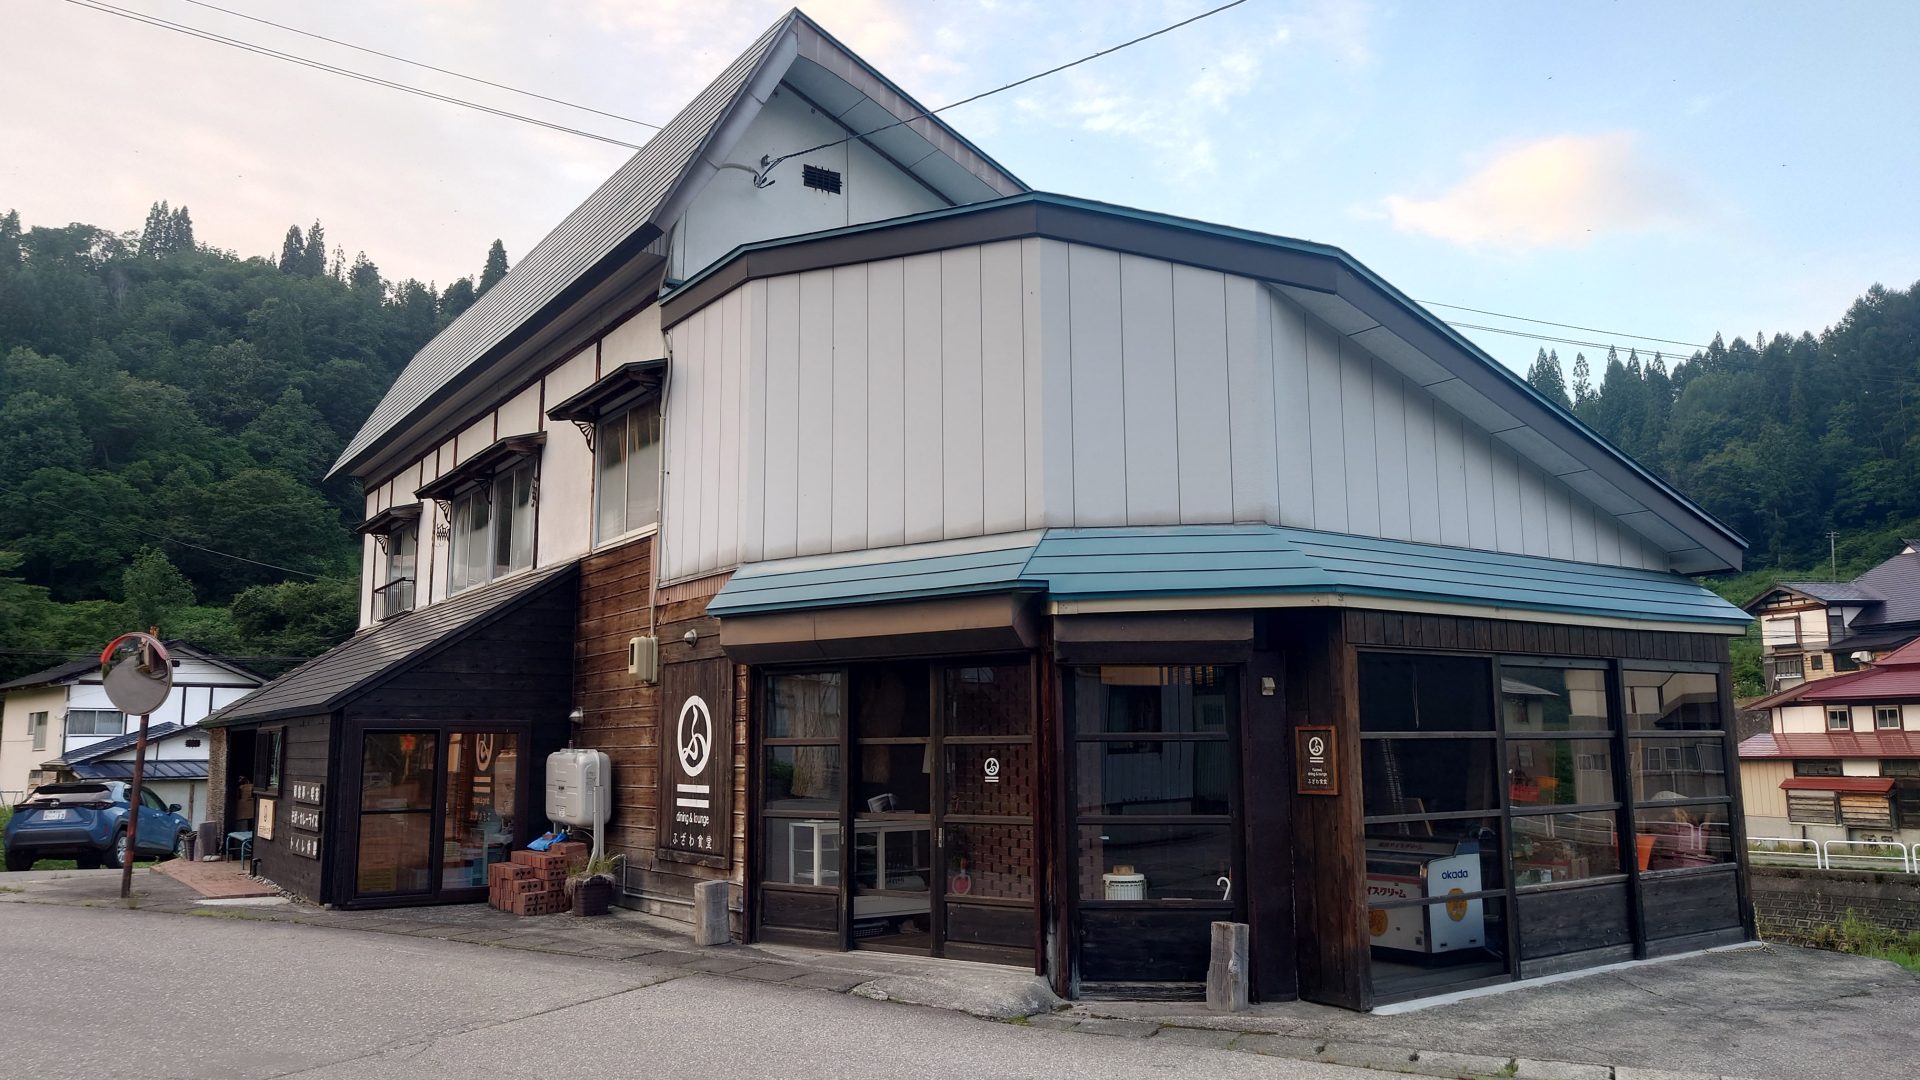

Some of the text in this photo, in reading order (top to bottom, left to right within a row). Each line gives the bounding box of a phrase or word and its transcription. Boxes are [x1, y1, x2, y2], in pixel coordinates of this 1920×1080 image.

[676, 811, 710, 827] dining & lounge
[672, 832, 712, 850] ふざわ食堂
[1441, 869, 1468, 880] okada
